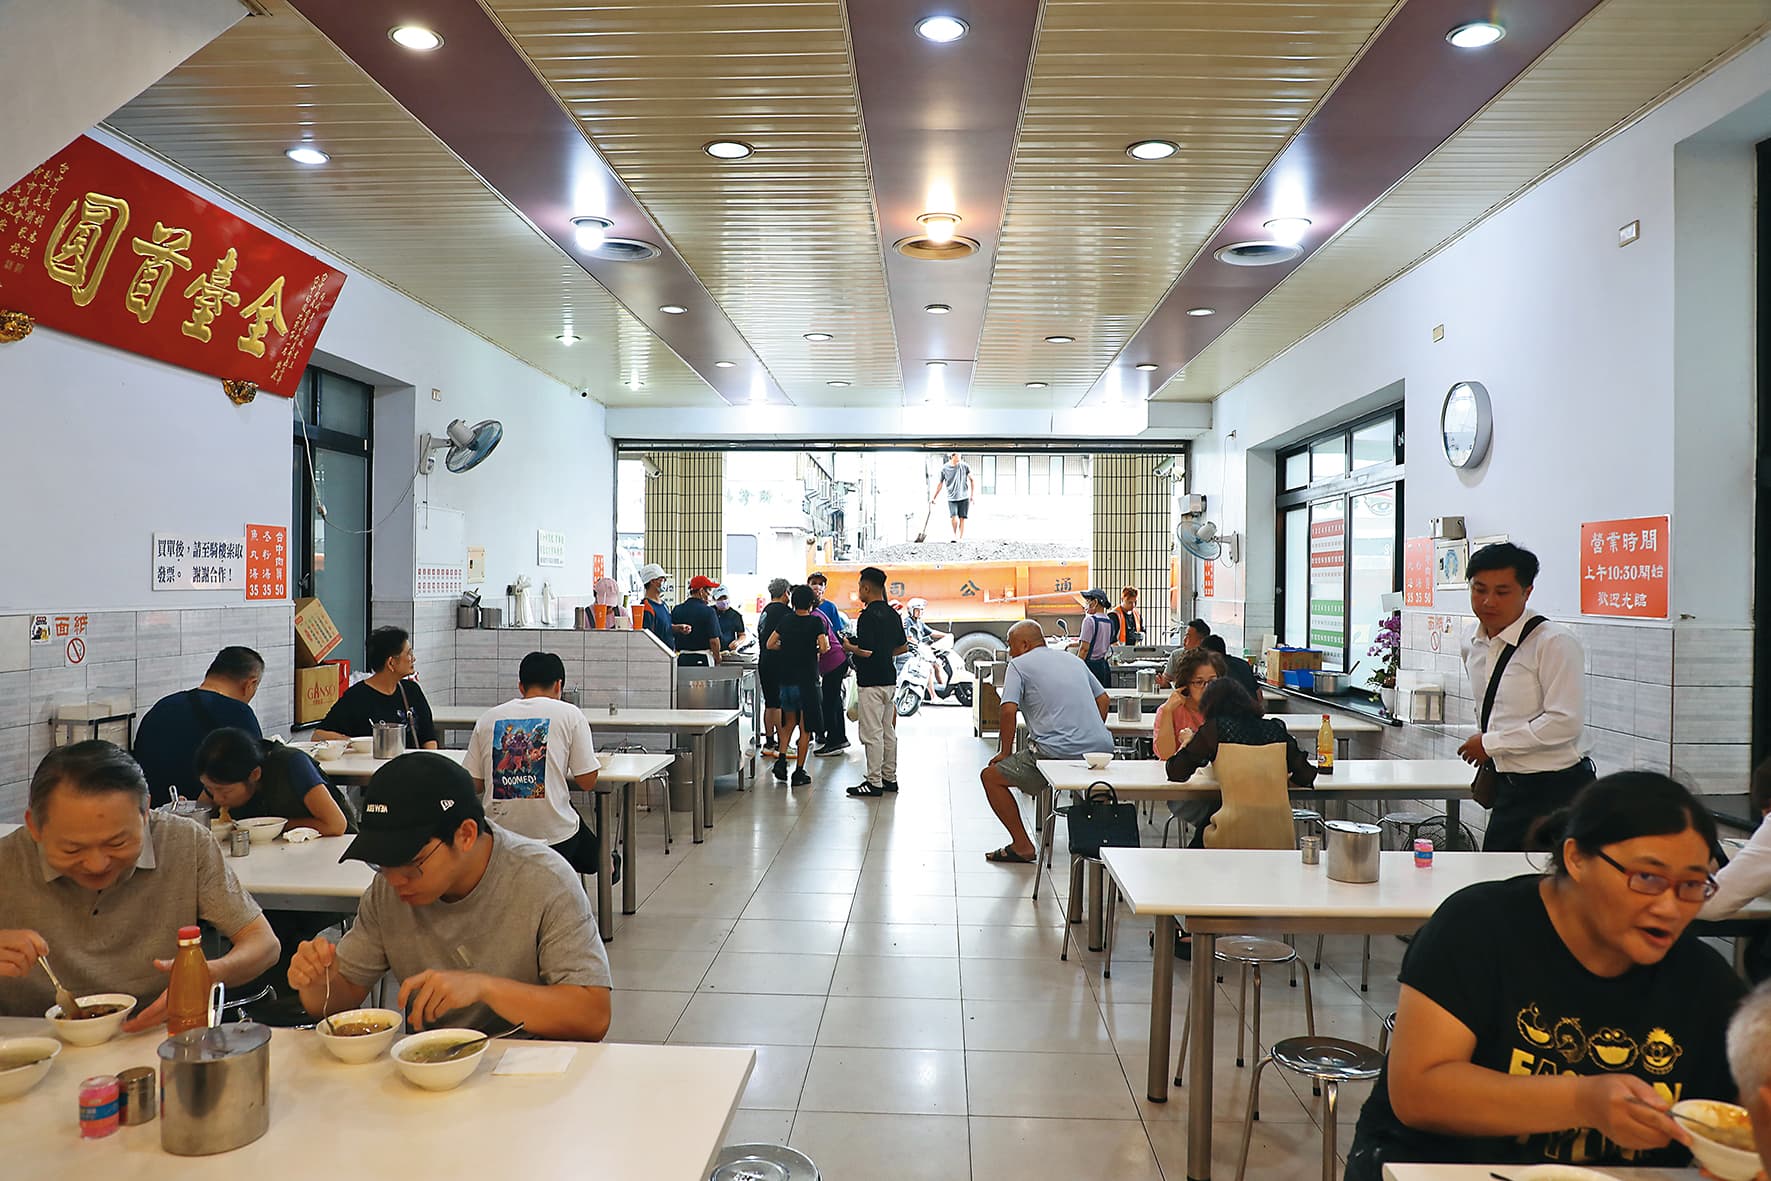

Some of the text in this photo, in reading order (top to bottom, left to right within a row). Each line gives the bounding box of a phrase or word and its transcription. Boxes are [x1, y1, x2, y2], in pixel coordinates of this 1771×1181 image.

[1590, 528, 1657, 554] 營業時間
[157, 566, 232, 583] 發票。 謝謝合作！
[1584, 564, 1664, 582] 上午10:30開始
[249, 584, 259, 596] 35
[262, 584, 272, 596] 35
[275, 584, 284, 596] 50
[889, 581, 906, 598] 司
[959, 579, 981, 597] 公
[1598, 591, 1648, 609] 歡迎光臨
[502, 775, 537, 786] DOOMED!
